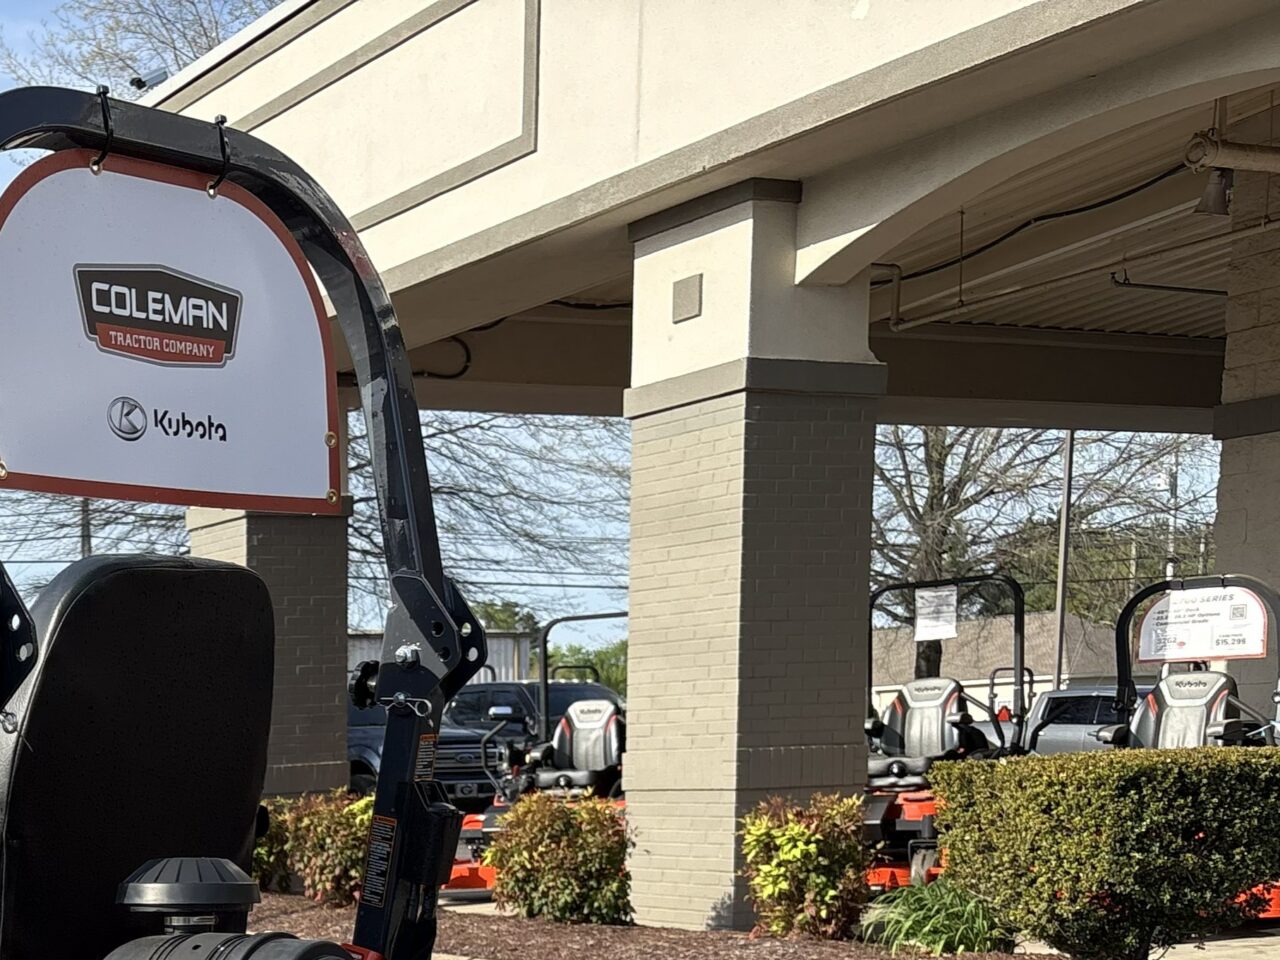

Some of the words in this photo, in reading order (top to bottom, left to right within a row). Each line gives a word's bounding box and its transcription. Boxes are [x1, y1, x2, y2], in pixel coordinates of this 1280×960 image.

[91, 281, 228, 331] COLEMAN
[109, 330, 161, 351] TRACTOR
[163, 339, 215, 358] COMPANY
[153, 408, 227, 442] Kubota
[1199, 593, 1236, 604] SERIES
[1175, 680, 1208, 688] Kubota
